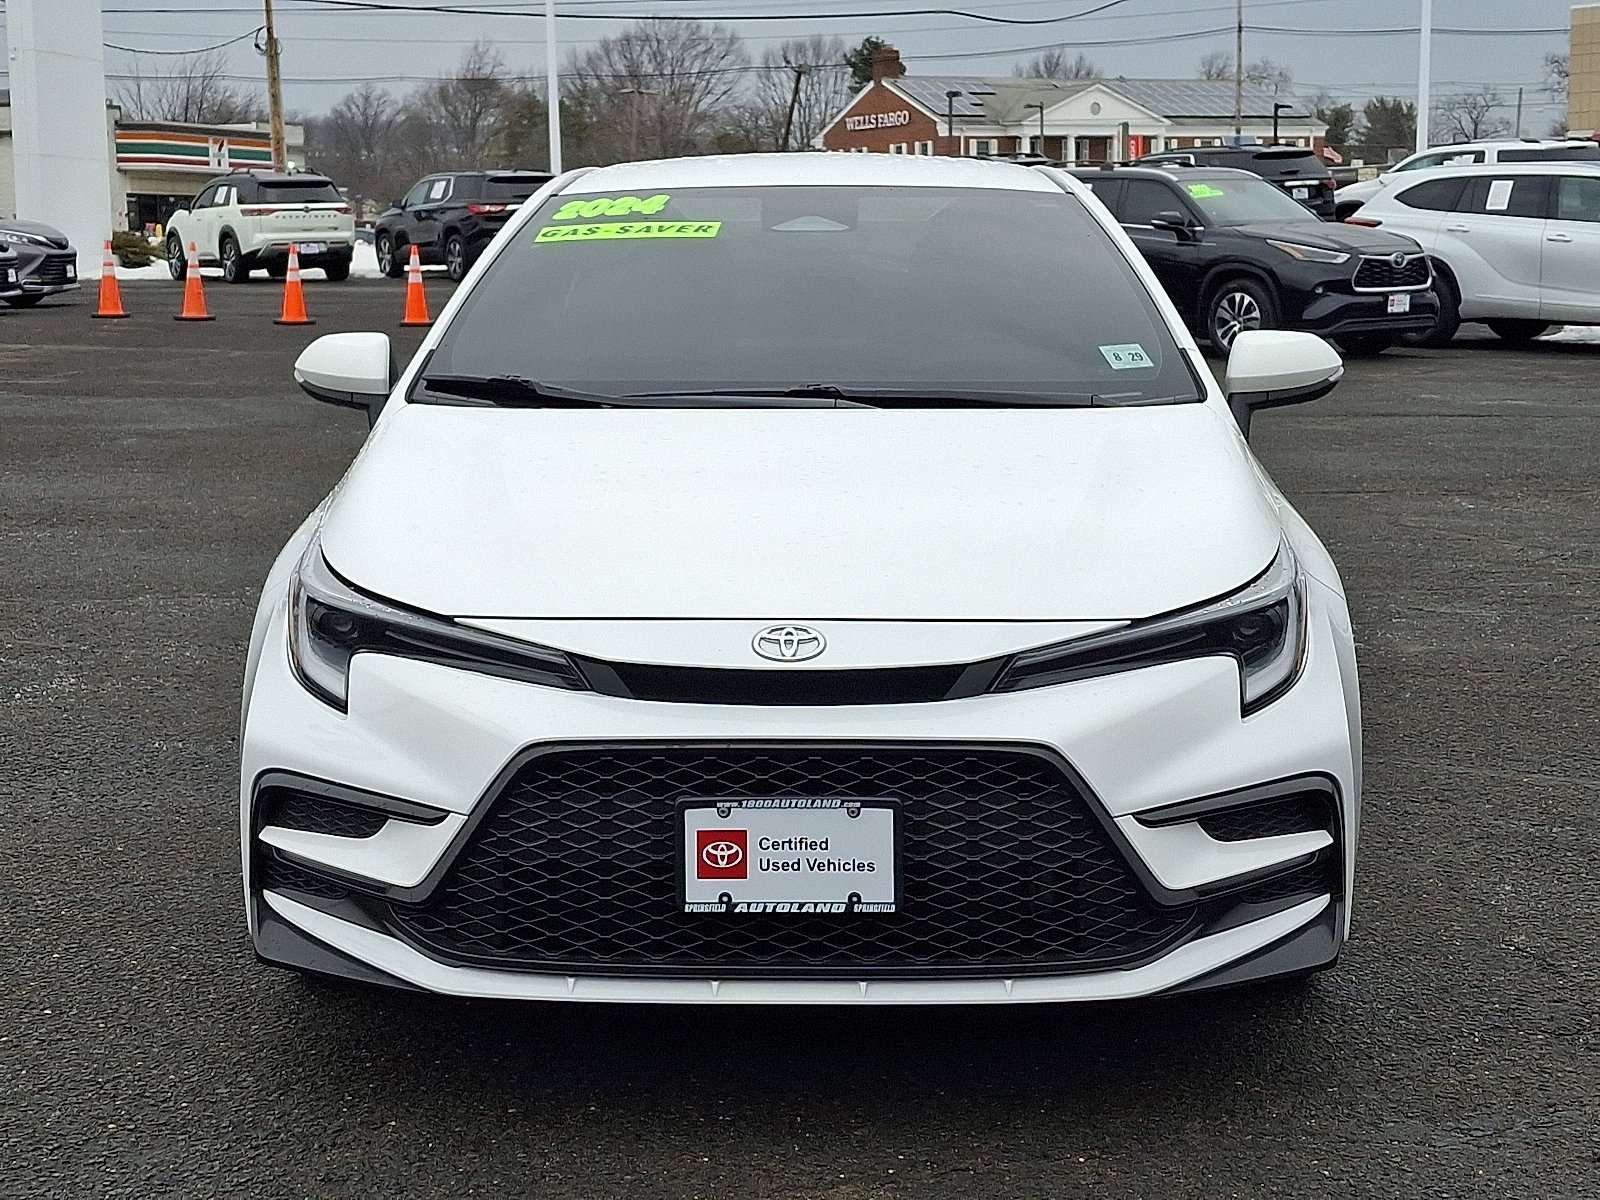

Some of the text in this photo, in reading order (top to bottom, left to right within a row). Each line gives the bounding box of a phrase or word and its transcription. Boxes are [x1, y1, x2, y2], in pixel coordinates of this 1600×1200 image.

[845, 110, 910, 131] WELLS FARGO
[552, 194, 671, 220] 2024
[540, 224, 714, 238] GAS-SAVER
[1112, 352, 1144, 362] 8 29
[716, 799, 861, 809] www.1800AUTOLAND.com
[758, 837, 830, 851] Certified
[758, 858, 876, 872] Used Vehicles
[684, 903, 727, 913] SPRINGFIELD
[734, 903, 847, 913] AUTOLAND
[853, 903, 896, 913] SPRINGFIELD
